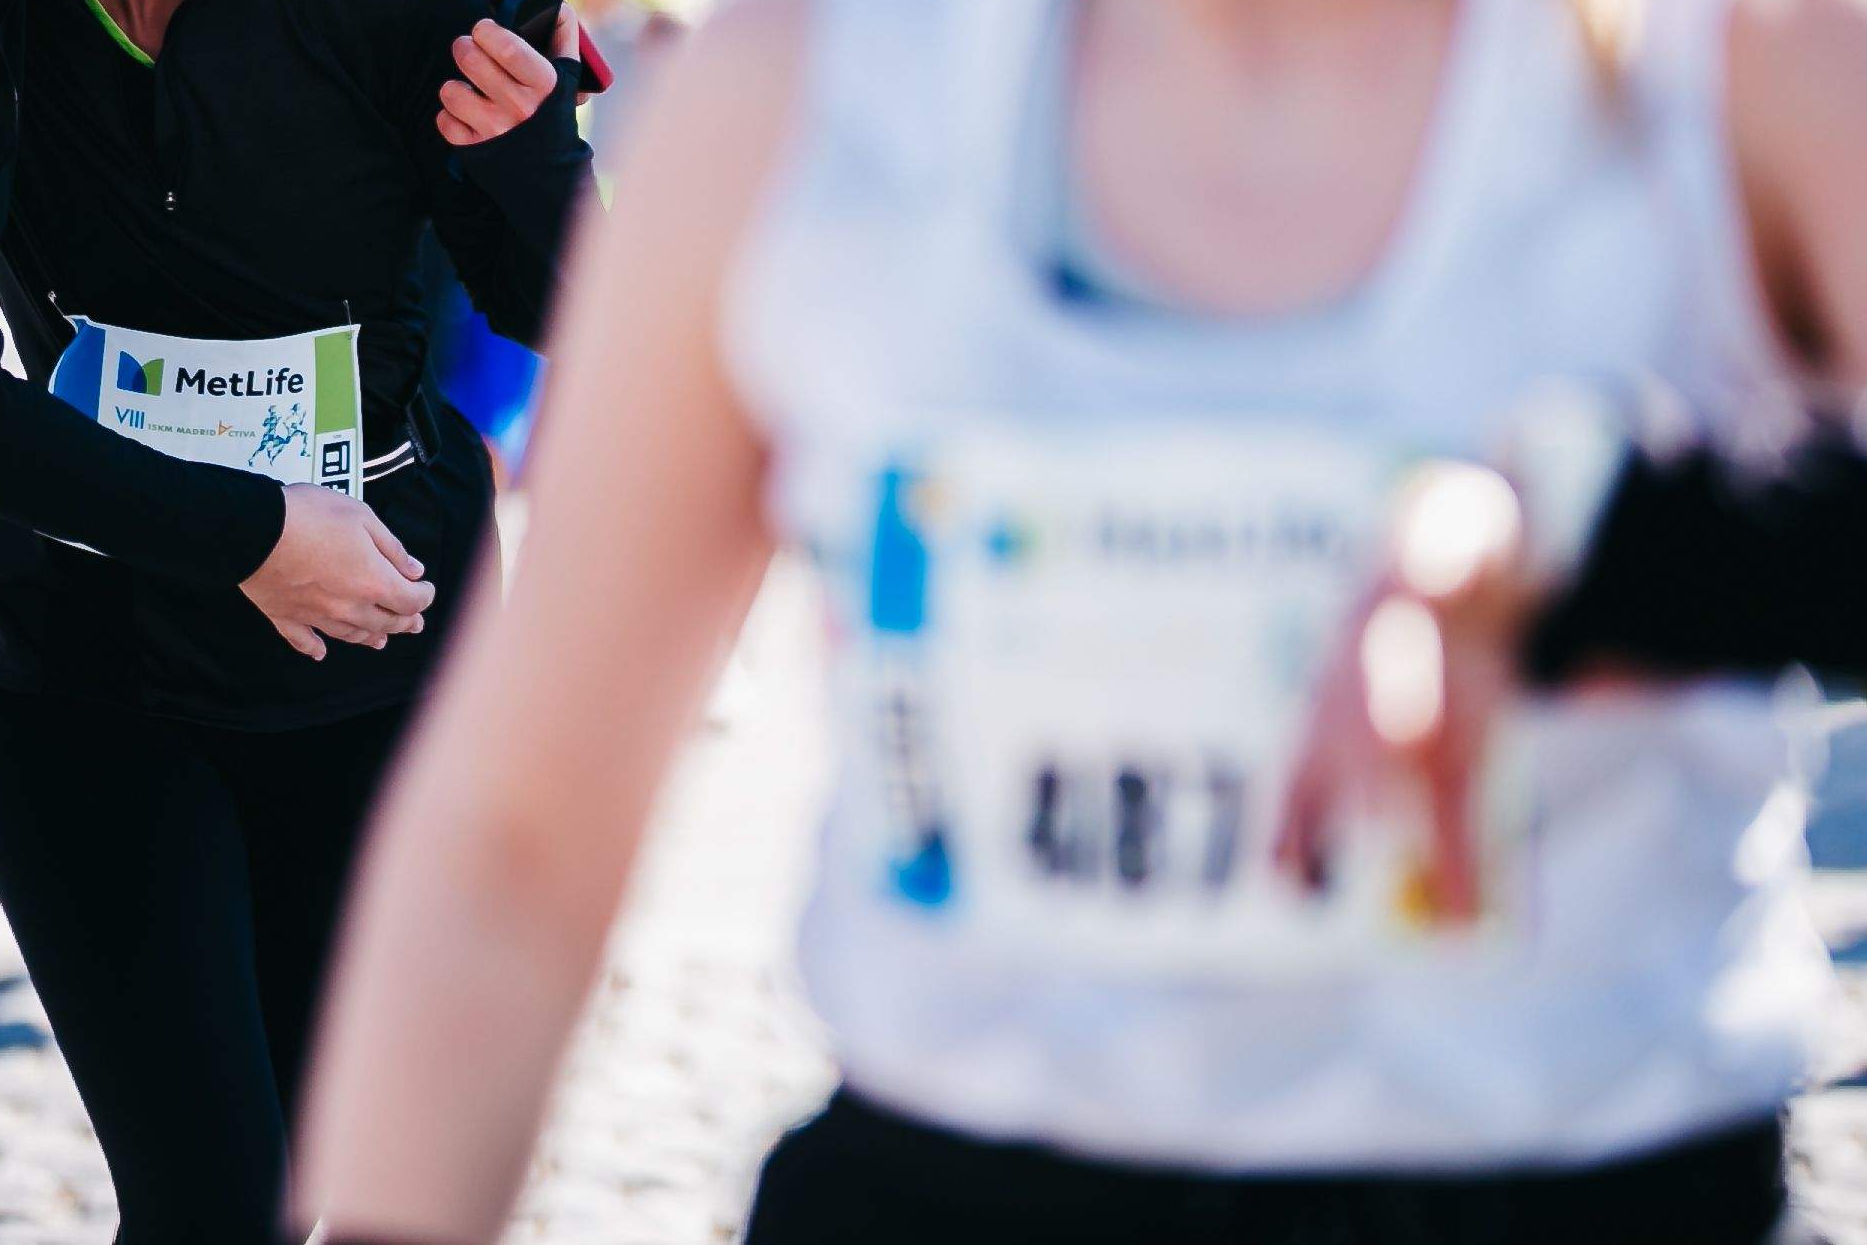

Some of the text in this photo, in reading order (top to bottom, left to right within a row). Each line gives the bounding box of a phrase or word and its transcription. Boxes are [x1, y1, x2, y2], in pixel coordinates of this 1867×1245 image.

[175, 366, 305, 397] MetLife
[115, 405, 146, 430] VIII
[147, 423, 173, 433] 15KM
[176, 426, 217, 437] MADRID
[1025, 758, 1328, 891] 487
